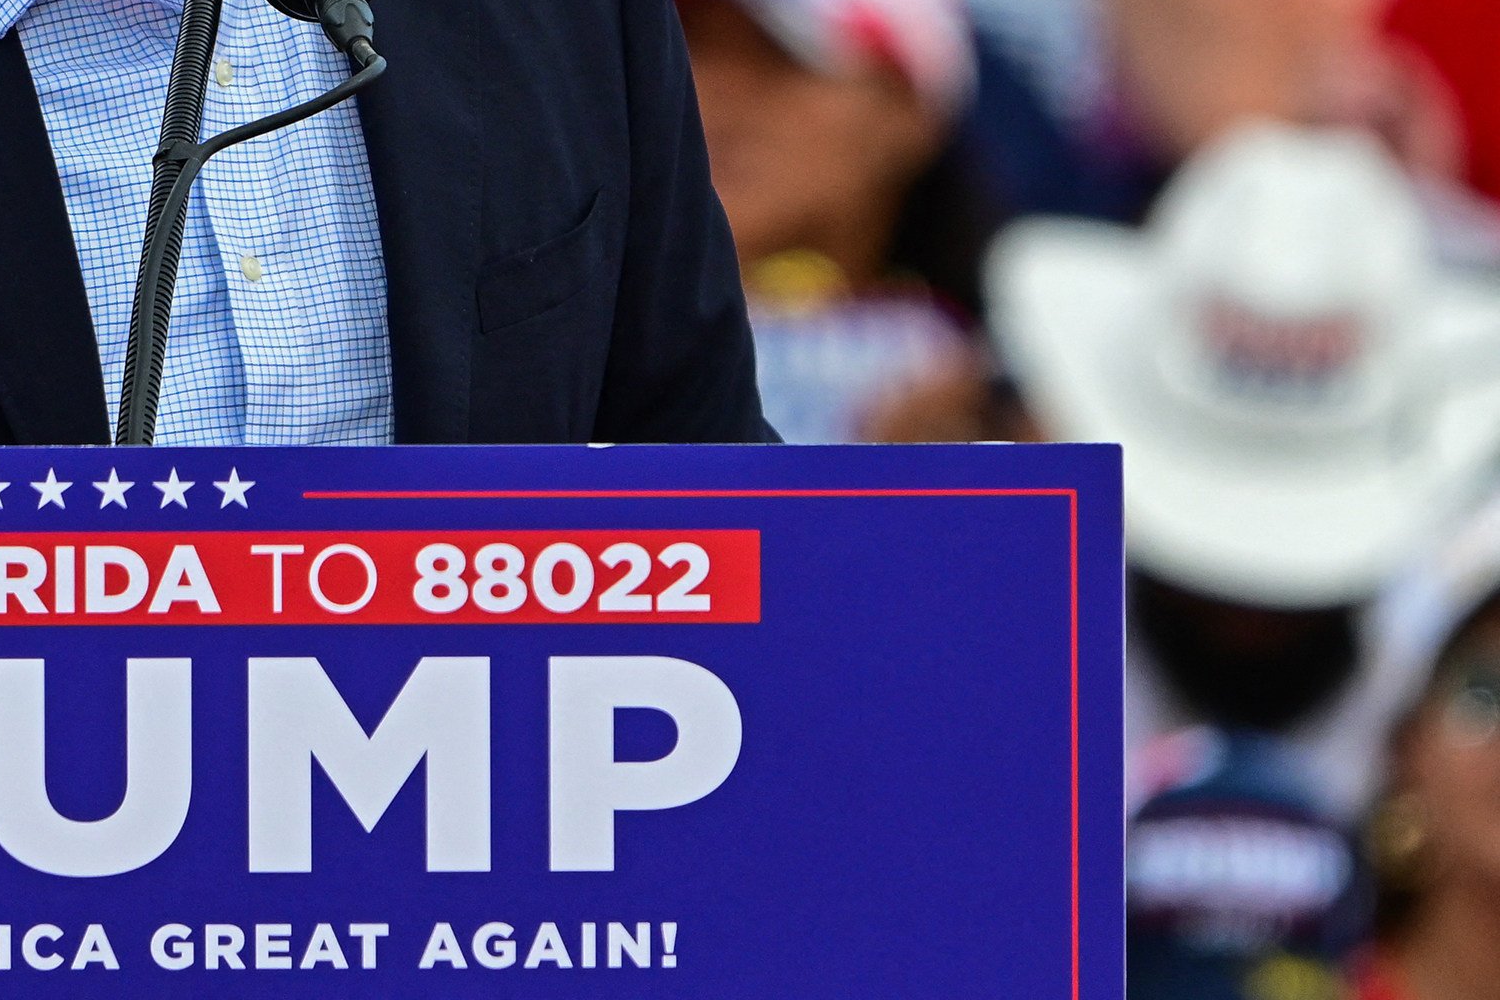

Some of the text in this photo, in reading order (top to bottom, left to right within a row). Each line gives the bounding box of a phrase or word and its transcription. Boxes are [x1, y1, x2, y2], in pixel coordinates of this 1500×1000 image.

[250, 543, 378, 615] TO
[412, 541, 711, 614] 88022
[150, 922, 390, 971] GREAT
[418, 921, 678, 970] AGAIN!
